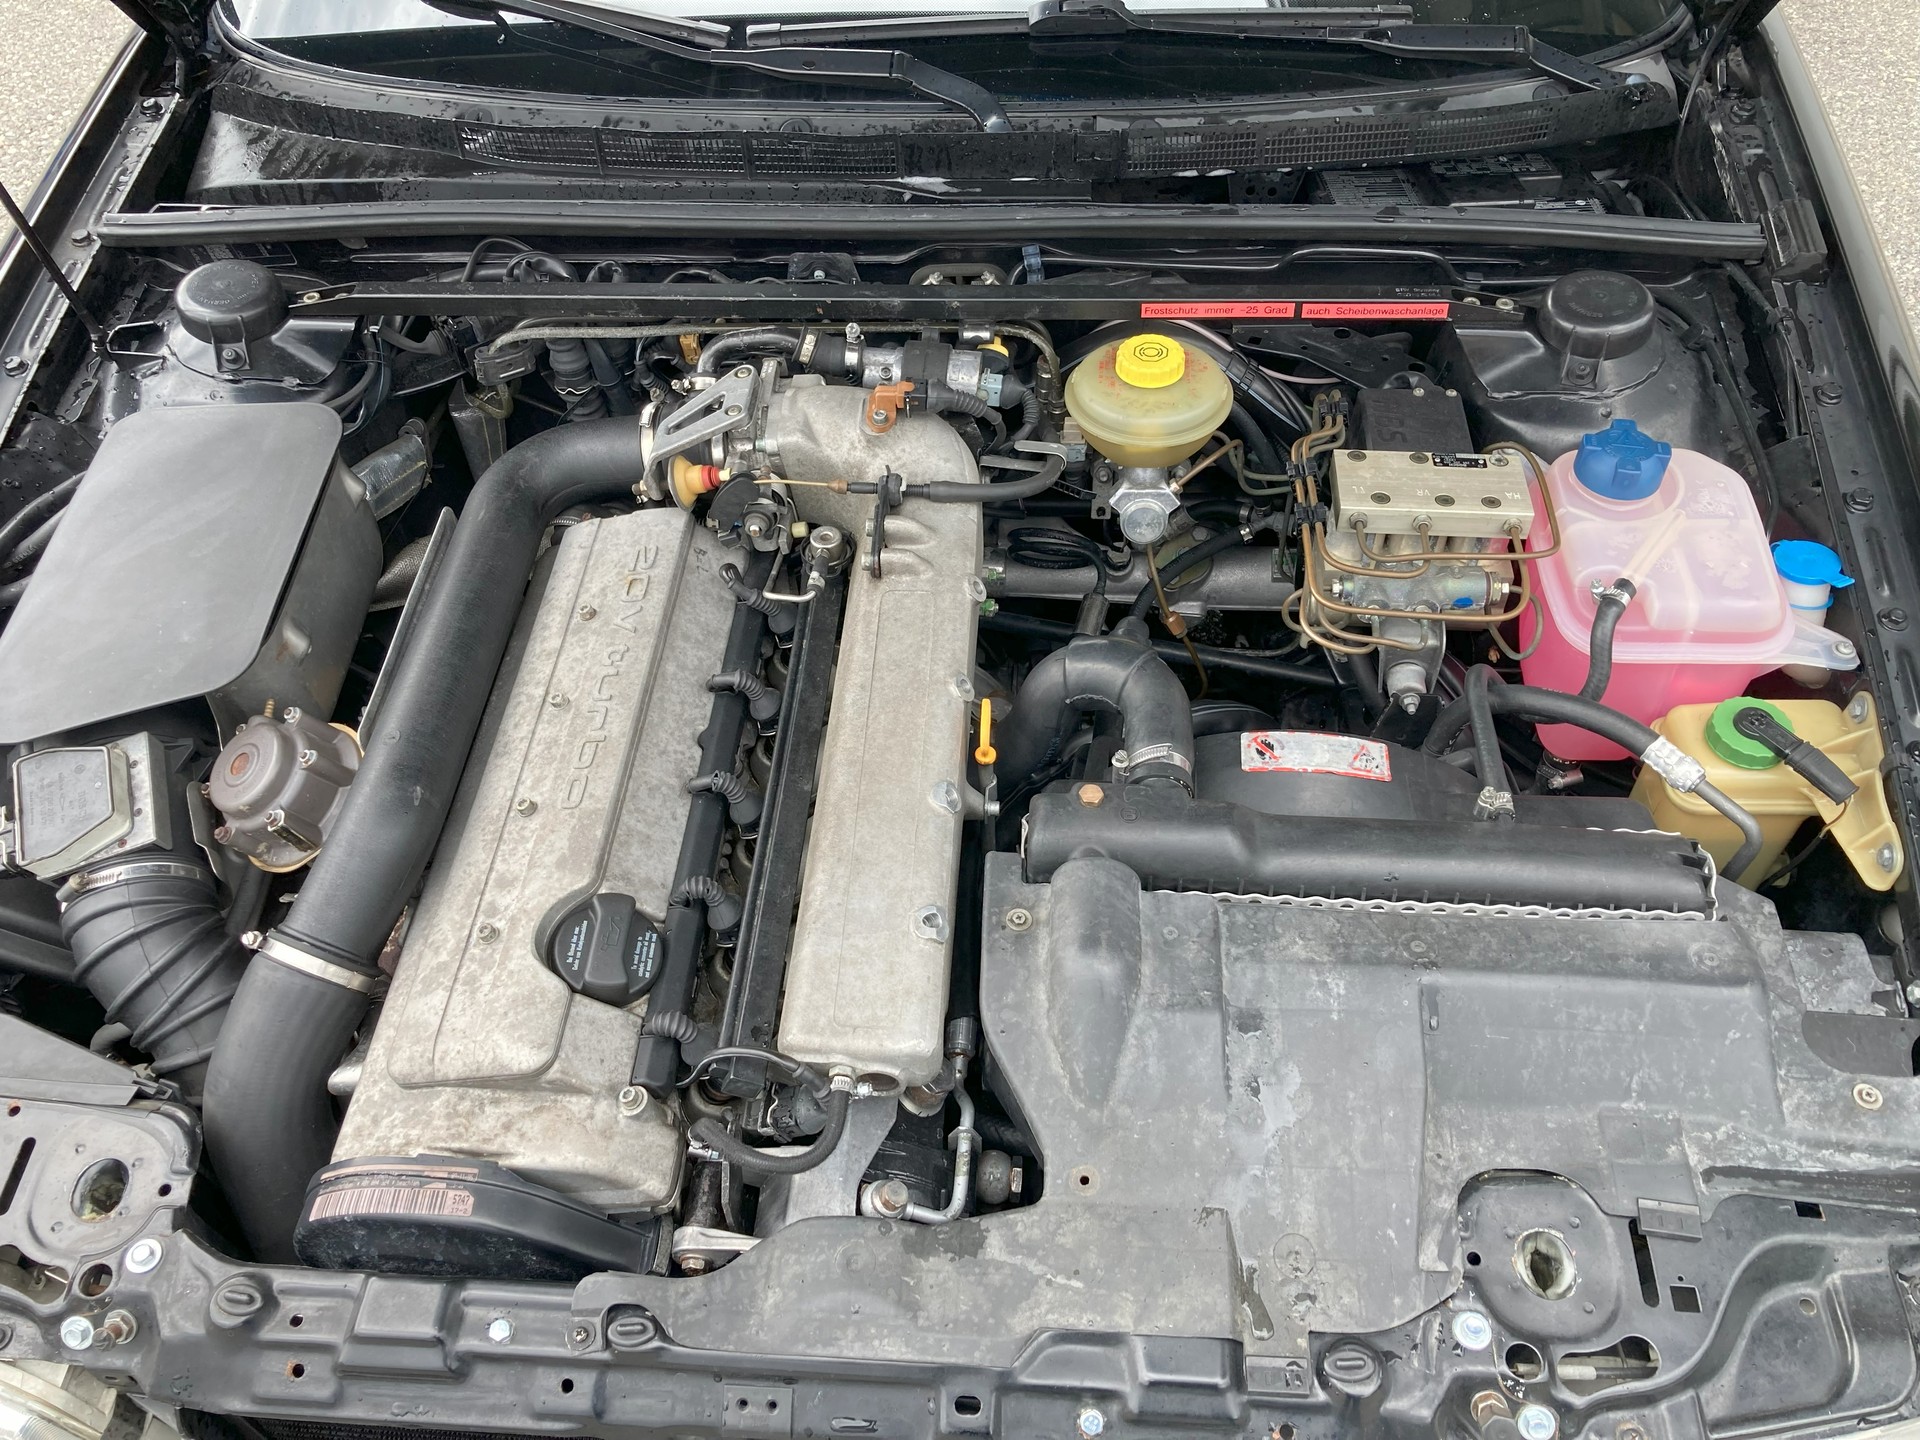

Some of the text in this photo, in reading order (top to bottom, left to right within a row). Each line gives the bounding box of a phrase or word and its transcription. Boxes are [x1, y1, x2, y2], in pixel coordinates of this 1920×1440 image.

[1144, 305, 1288, 315] Frostschutz immer -25 Grad
[1306, 306, 1445, 317] auch Scheibenwaschanlage
[1416, 488, 1431, 497] VR
[1504, 491, 1521, 500] HA
[561, 544, 659, 810] 20V turbo
